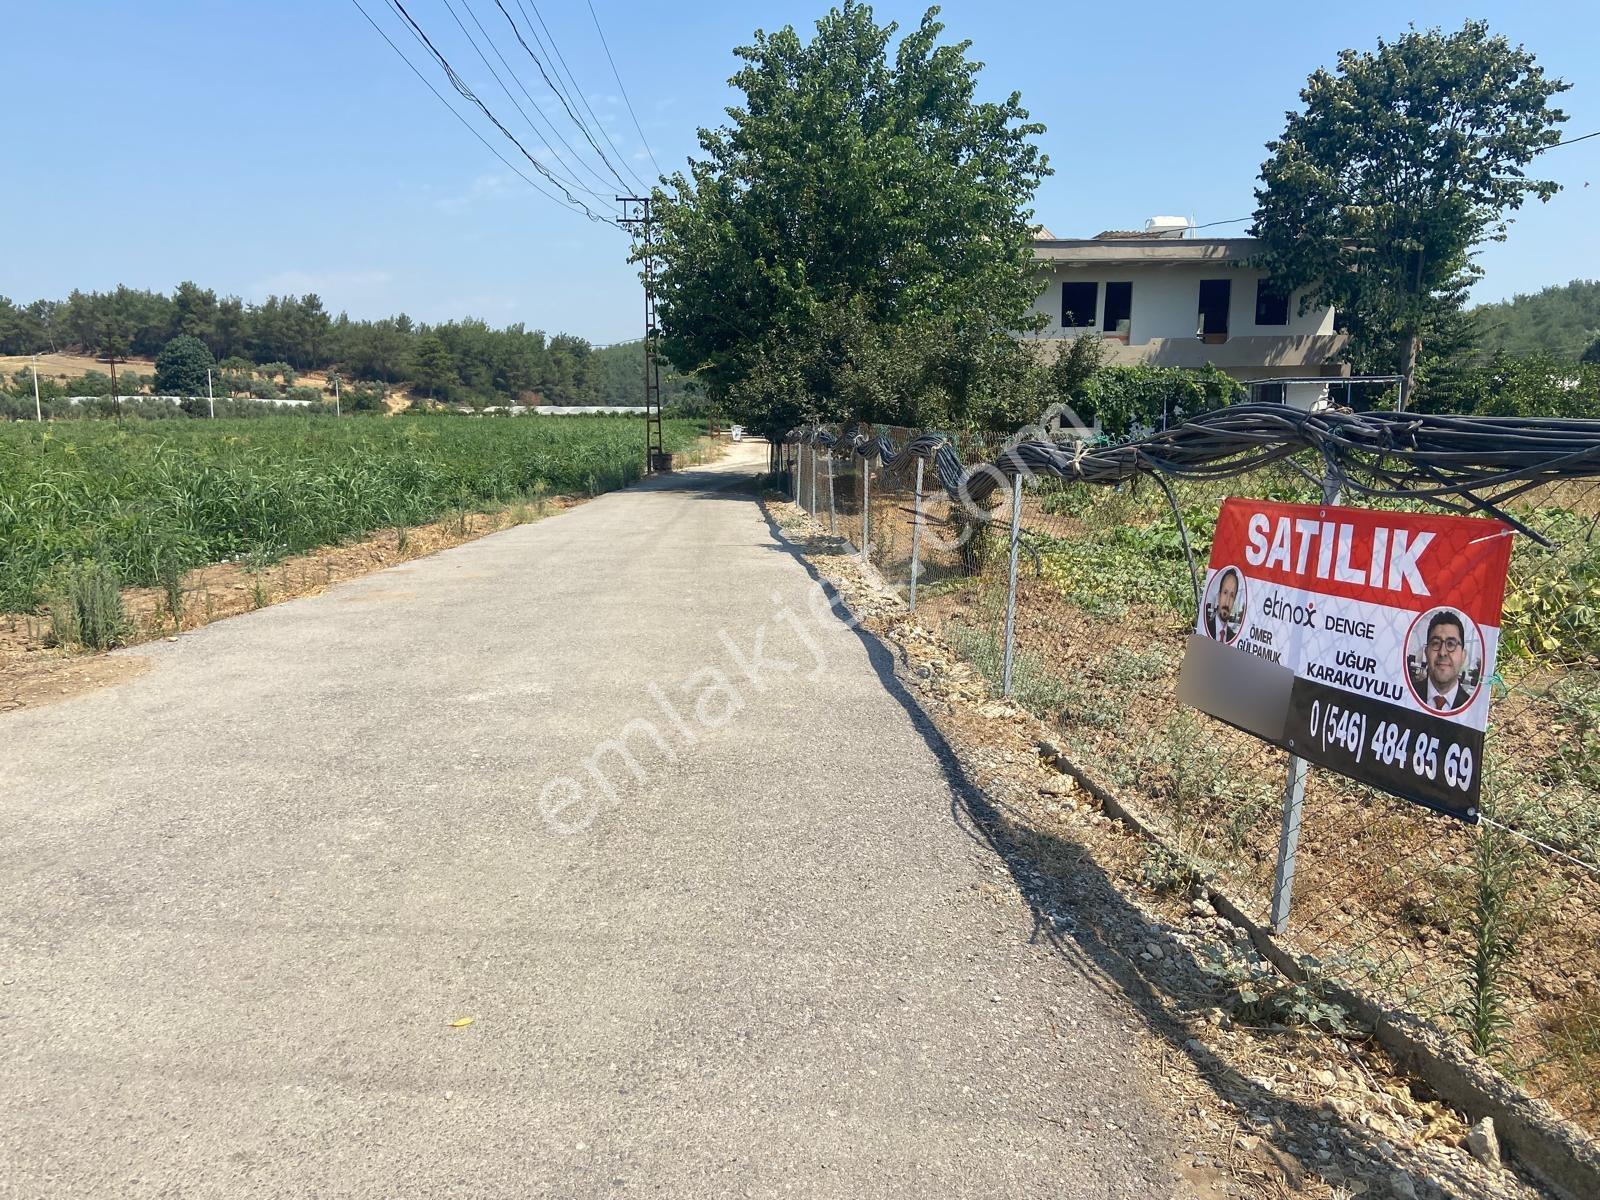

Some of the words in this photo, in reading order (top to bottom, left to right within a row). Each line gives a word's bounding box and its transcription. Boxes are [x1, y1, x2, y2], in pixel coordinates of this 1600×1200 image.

[1245, 513, 1437, 597] SATILIK
[1249, 624, 1273, 645] ÖMER
[1263, 590, 1317, 630] ekinox
[1325, 615, 1375, 640] DENGE
[1236, 638, 1282, 666] GÜLPAMUK
[1335, 650, 1377, 674] UĞUR
[1306, 662, 1403, 701] KARAKUYULU
[1309, 699, 1320, 738] 0
[1322, 703, 1367, 763] (546)
[1371, 720, 1411, 769] 484
[1413, 732, 1440, 780] 85
[1444, 743, 1472, 792] 69
